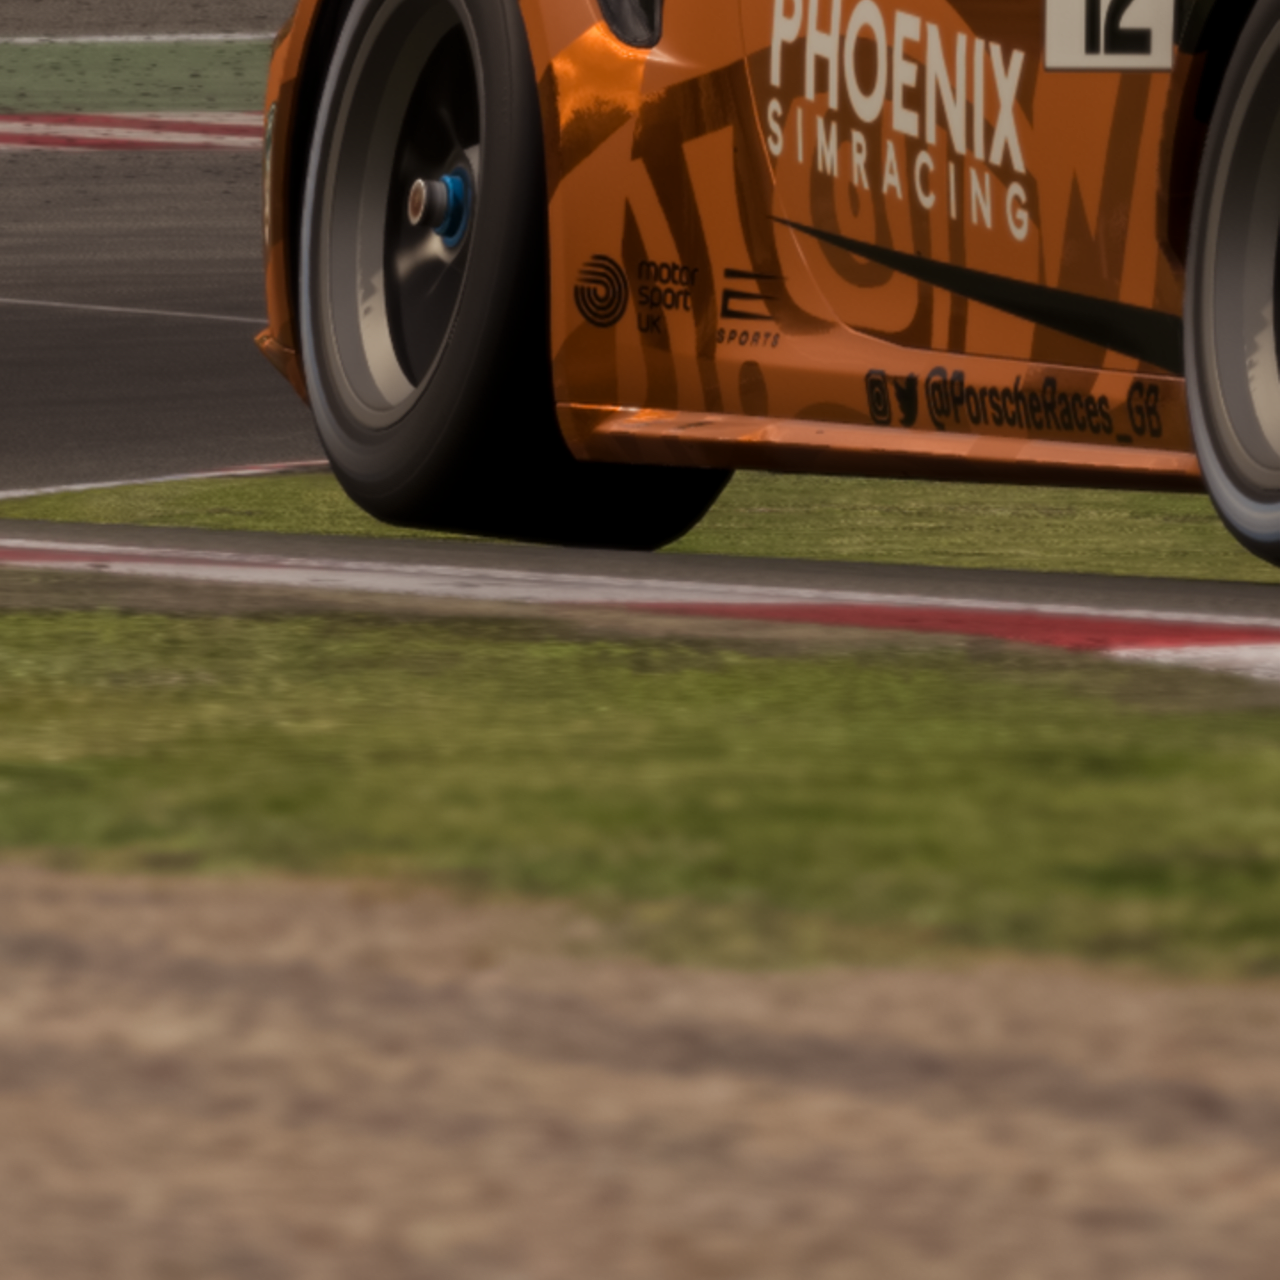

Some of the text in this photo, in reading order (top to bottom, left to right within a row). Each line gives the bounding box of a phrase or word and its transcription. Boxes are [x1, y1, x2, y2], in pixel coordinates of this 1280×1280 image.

[766, 97, 1029, 242] SIMRACING
[637, 260, 699, 286] motor
[637, 285, 691, 312] sport
[636, 312, 663, 335] UK
[716, 328, 782, 349] SPORTS
[924, 366, 1162, 443] @PorscheRaces_GB
